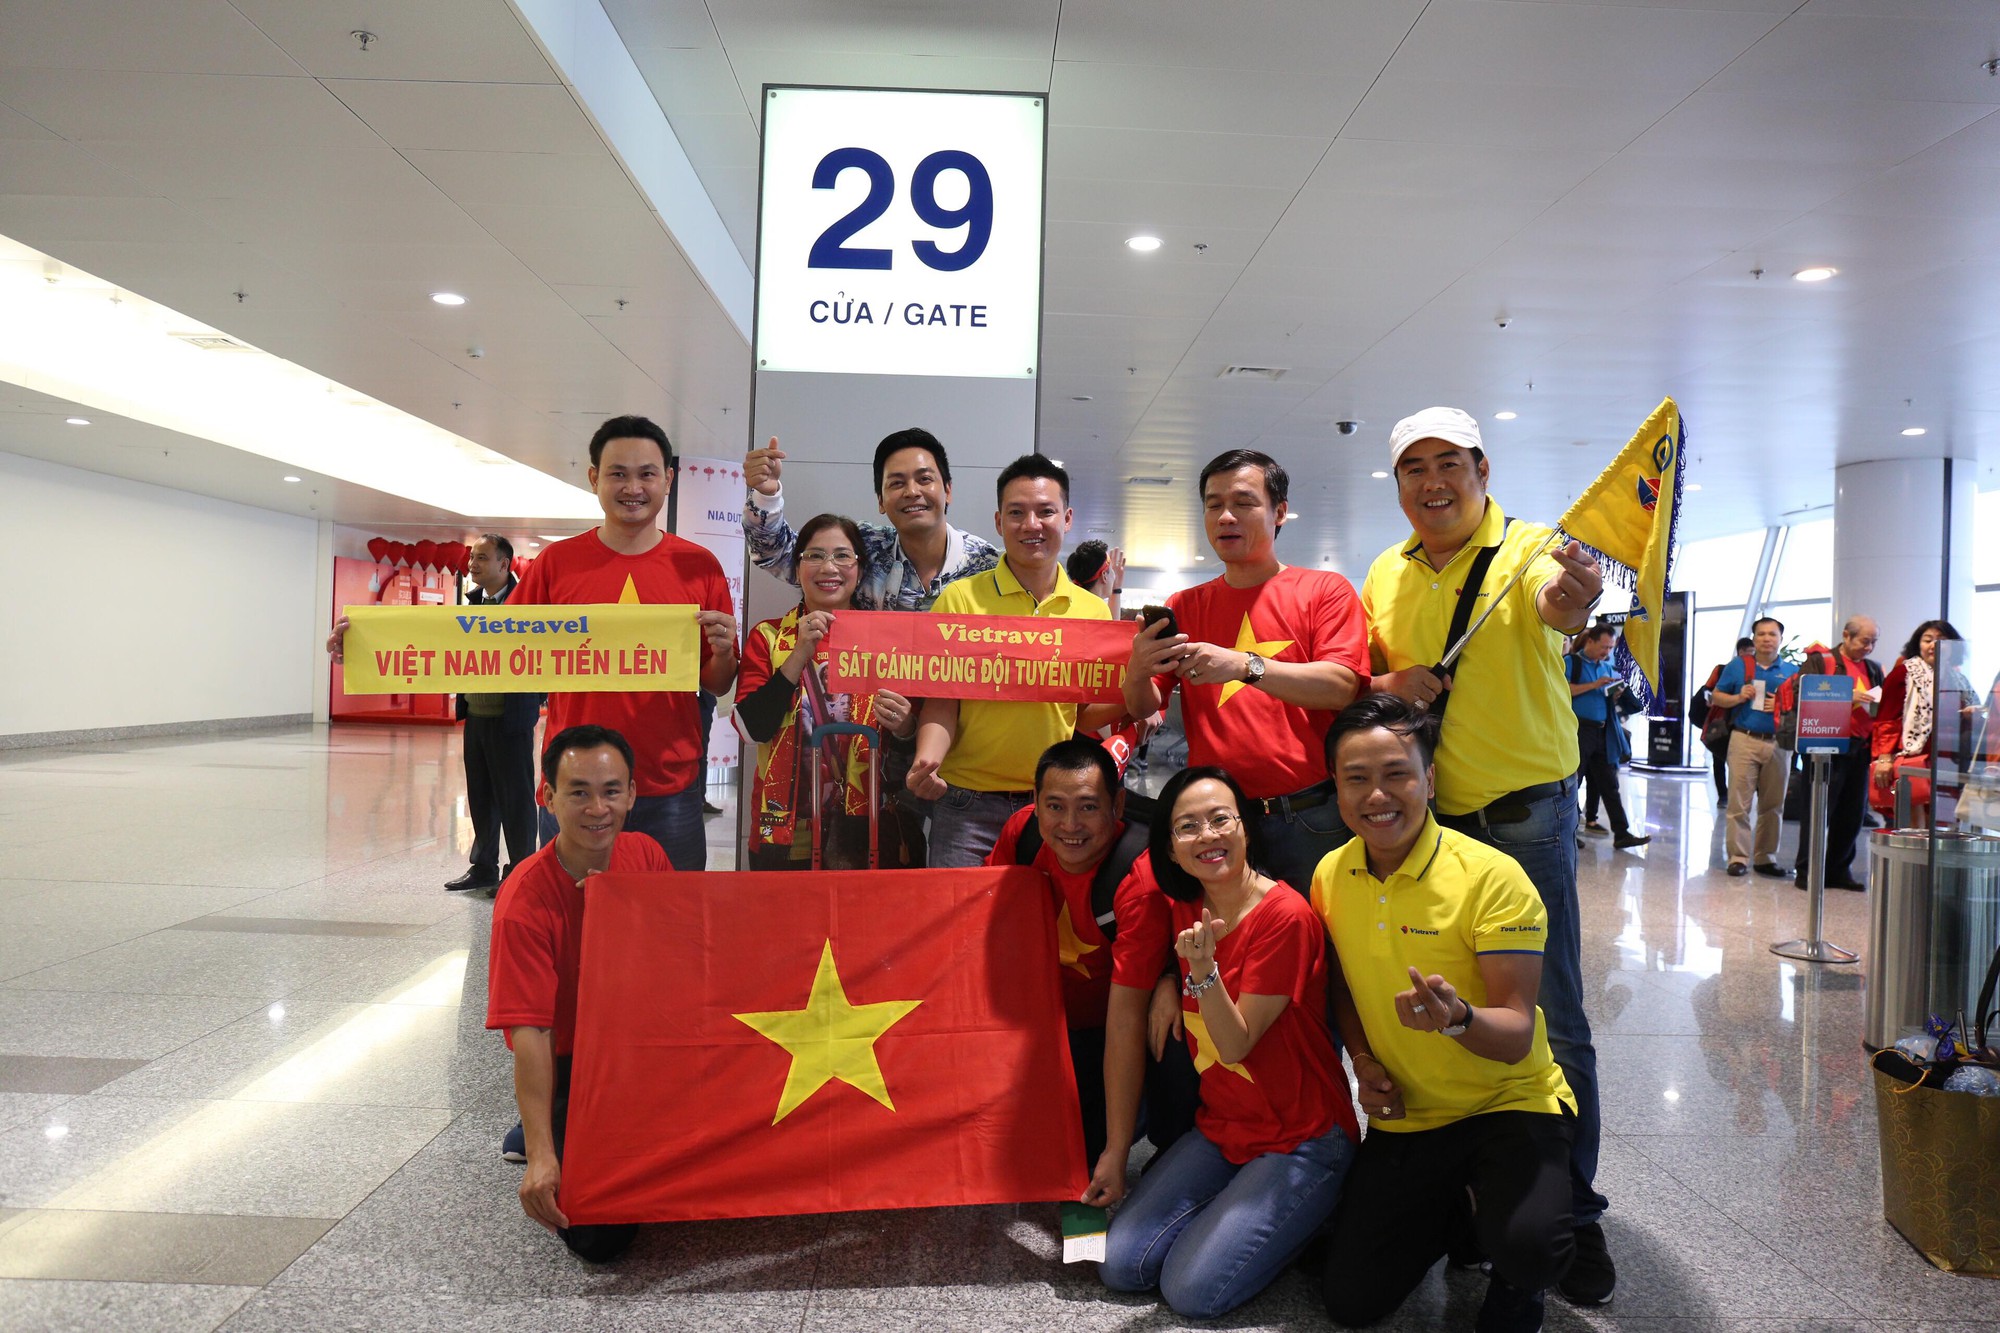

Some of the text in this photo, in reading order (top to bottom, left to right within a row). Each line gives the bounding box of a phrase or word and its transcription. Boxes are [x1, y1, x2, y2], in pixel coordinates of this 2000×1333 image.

[807, 146, 994, 272] 29
[809, 290, 874, 325] CỬA
[903, 302, 988, 327] GATE
[727, 512, 743, 524] DUT
[456, 615, 589, 634] Vietravel
[1606, 613, 1627, 624] SONY
[936, 622, 1063, 646] Vietravel
[375, 637, 667, 684] VIỆT NAM ƠI! TIẾN LÊN
[838, 645, 872, 678] SÁT
[875, 646, 924, 680] CÁNH
[928, 649, 976, 683] CÙNG
[980, 653, 1010, 692] ĐỘI
[1015, 648, 1072, 687] TUYỂN
[1077, 657, 1115, 695] VIỆT
[1801, 726, 1840, 734] PRIORITY
[1802, 718, 1819, 726] SKY
[1410, 928, 1439, 936] Vietravel
